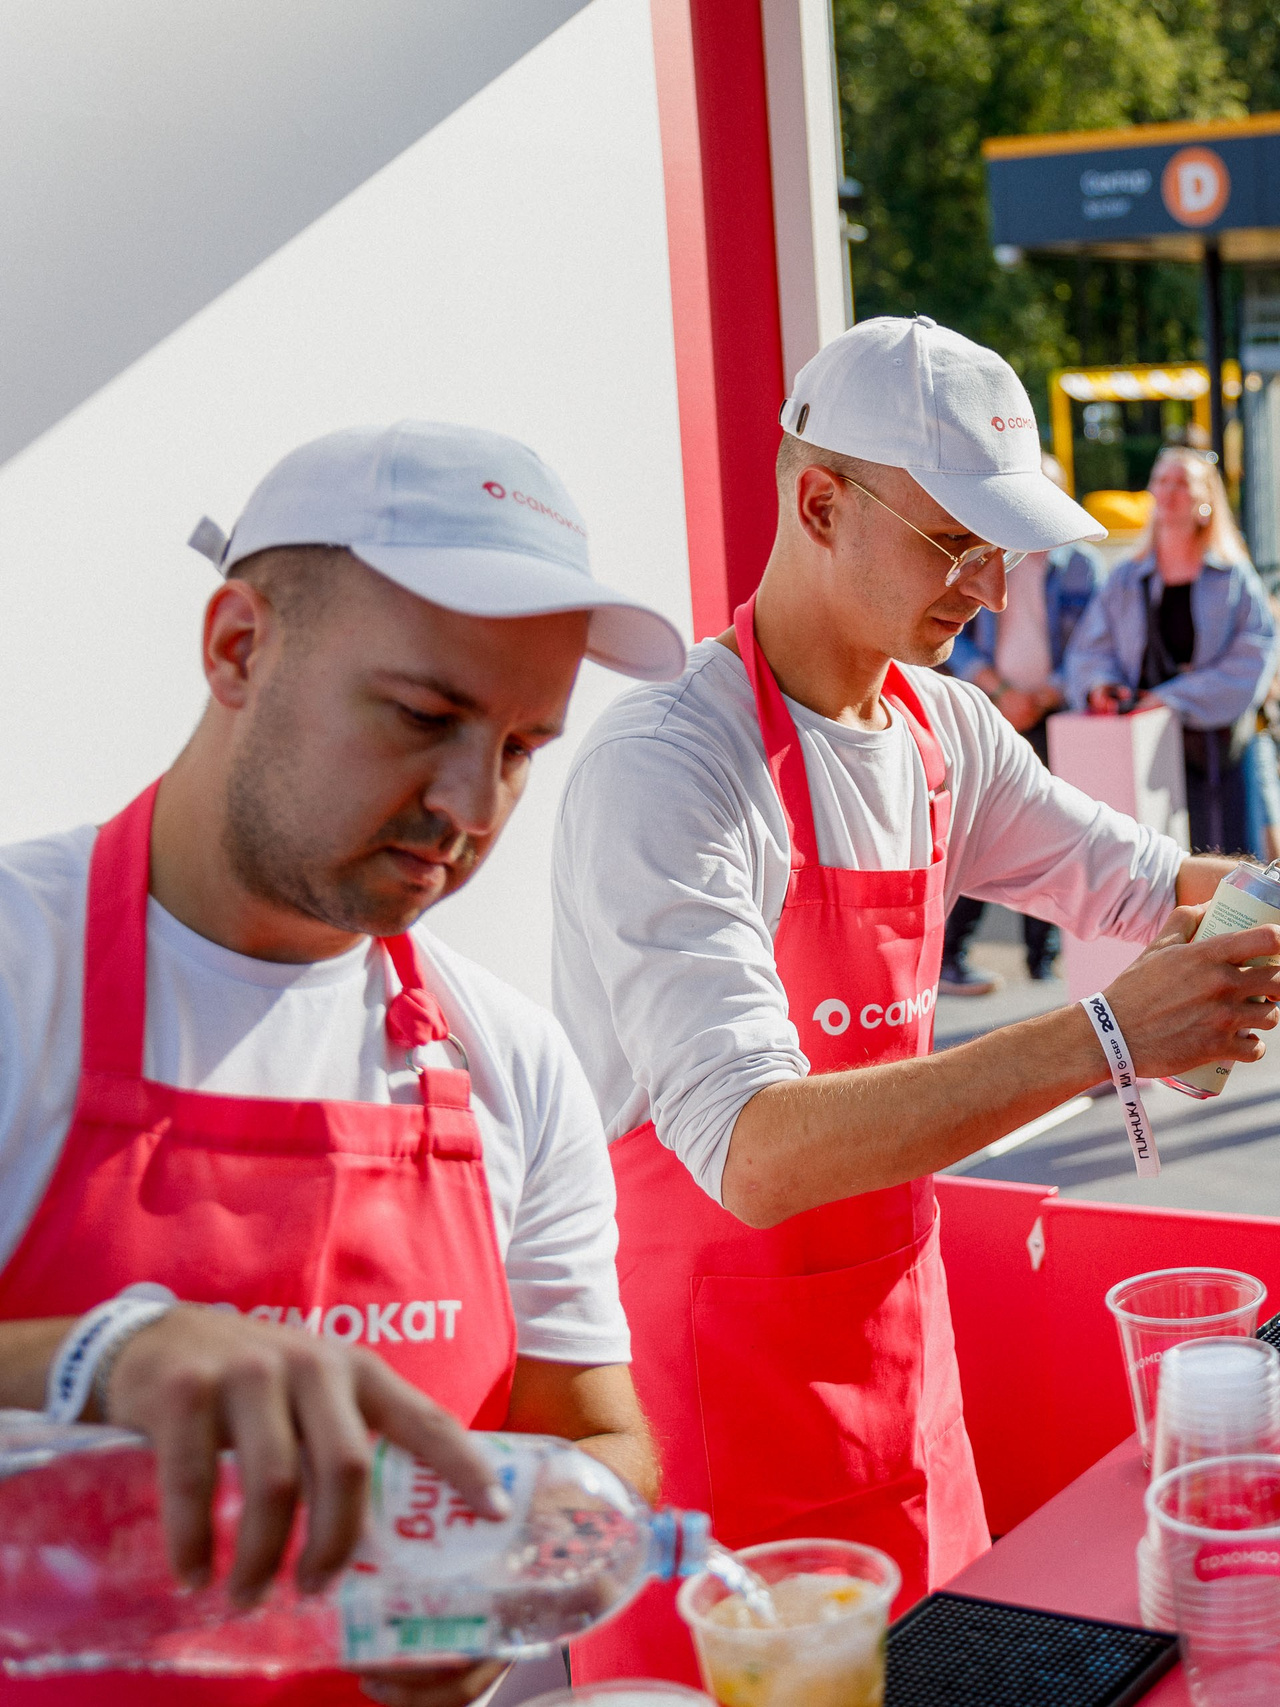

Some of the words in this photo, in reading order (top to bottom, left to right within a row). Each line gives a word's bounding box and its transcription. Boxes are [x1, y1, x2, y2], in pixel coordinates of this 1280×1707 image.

[1178, 160, 1219, 213] D
[1090, 997, 1115, 1033] 2024
[1110, 1038, 1123, 1060] СБЕР
[205, 1300, 463, 1344] мокат
